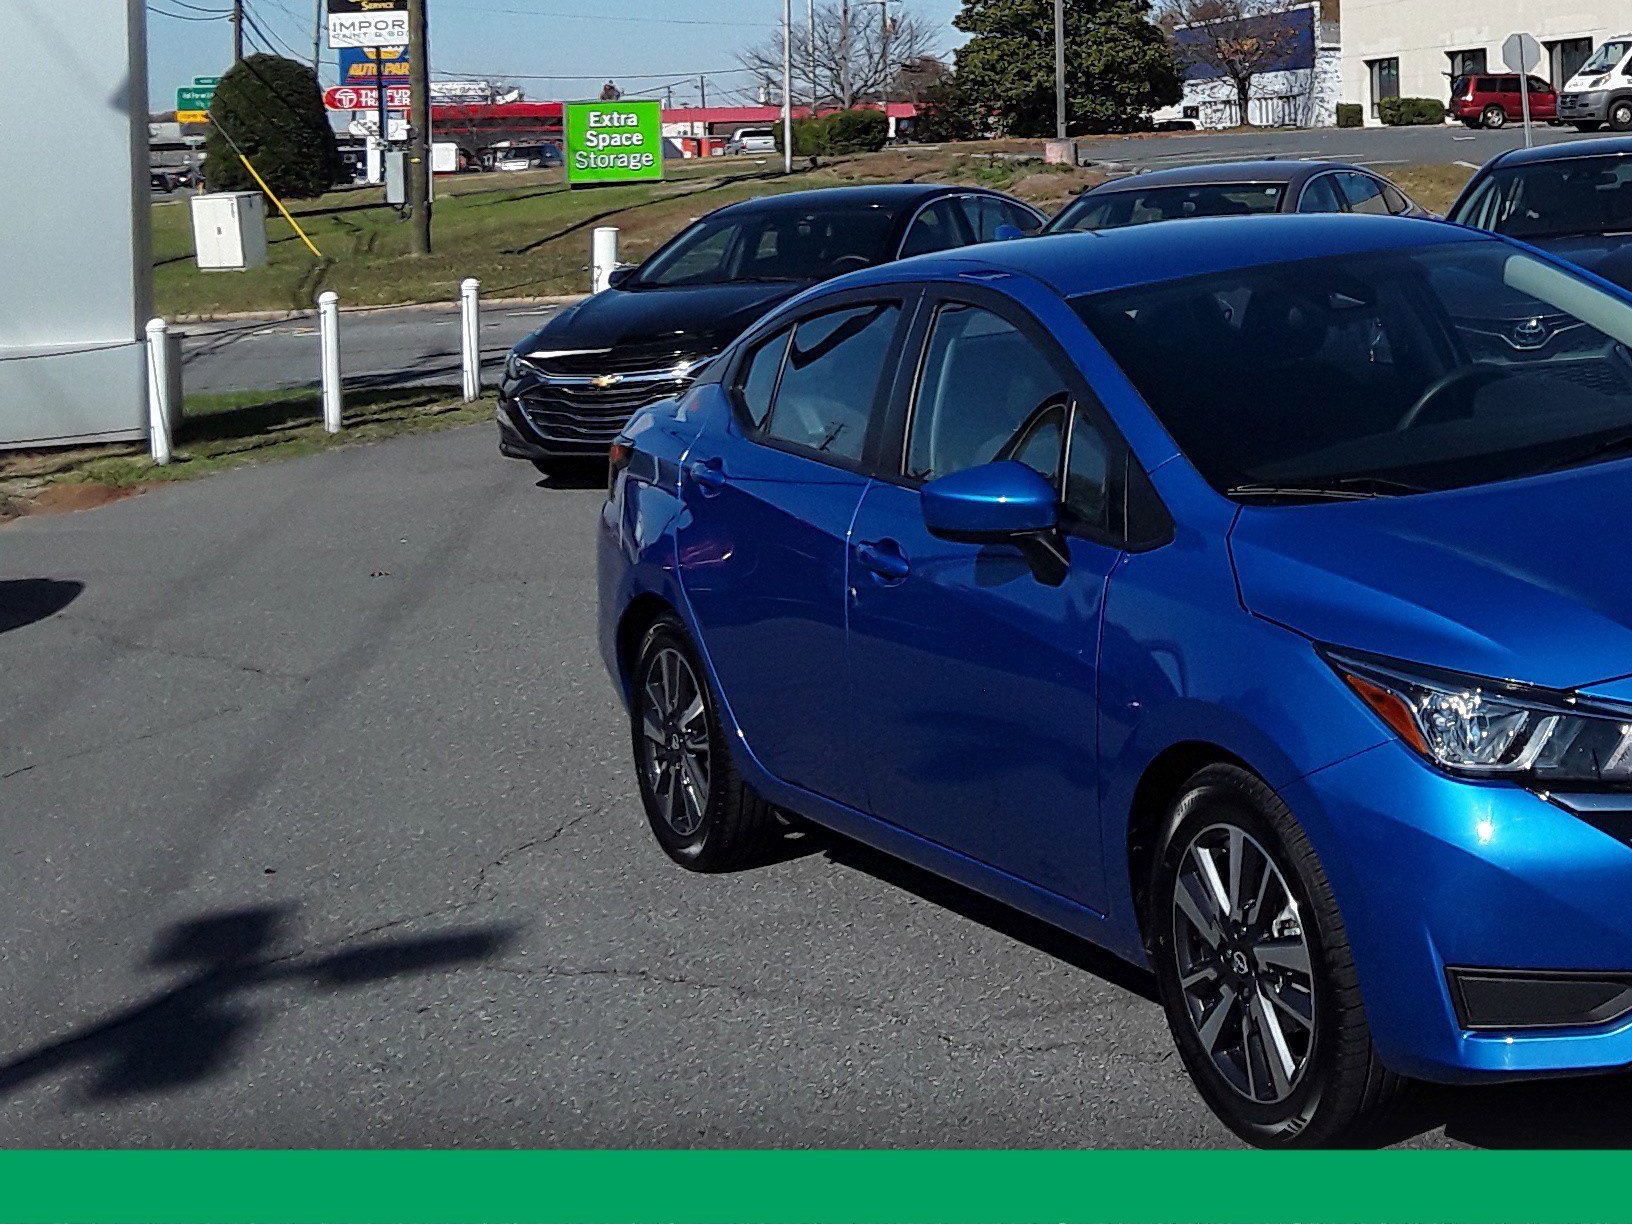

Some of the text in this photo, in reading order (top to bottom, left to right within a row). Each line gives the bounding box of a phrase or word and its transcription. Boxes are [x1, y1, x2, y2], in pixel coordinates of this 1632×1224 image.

[332, 19, 406, 32] IMPOR
[384, 62, 410, 76] PAR
[589, 112, 638, 127] Extra
[585, 130, 644, 150] Space
[575, 151, 654, 170] Storage
